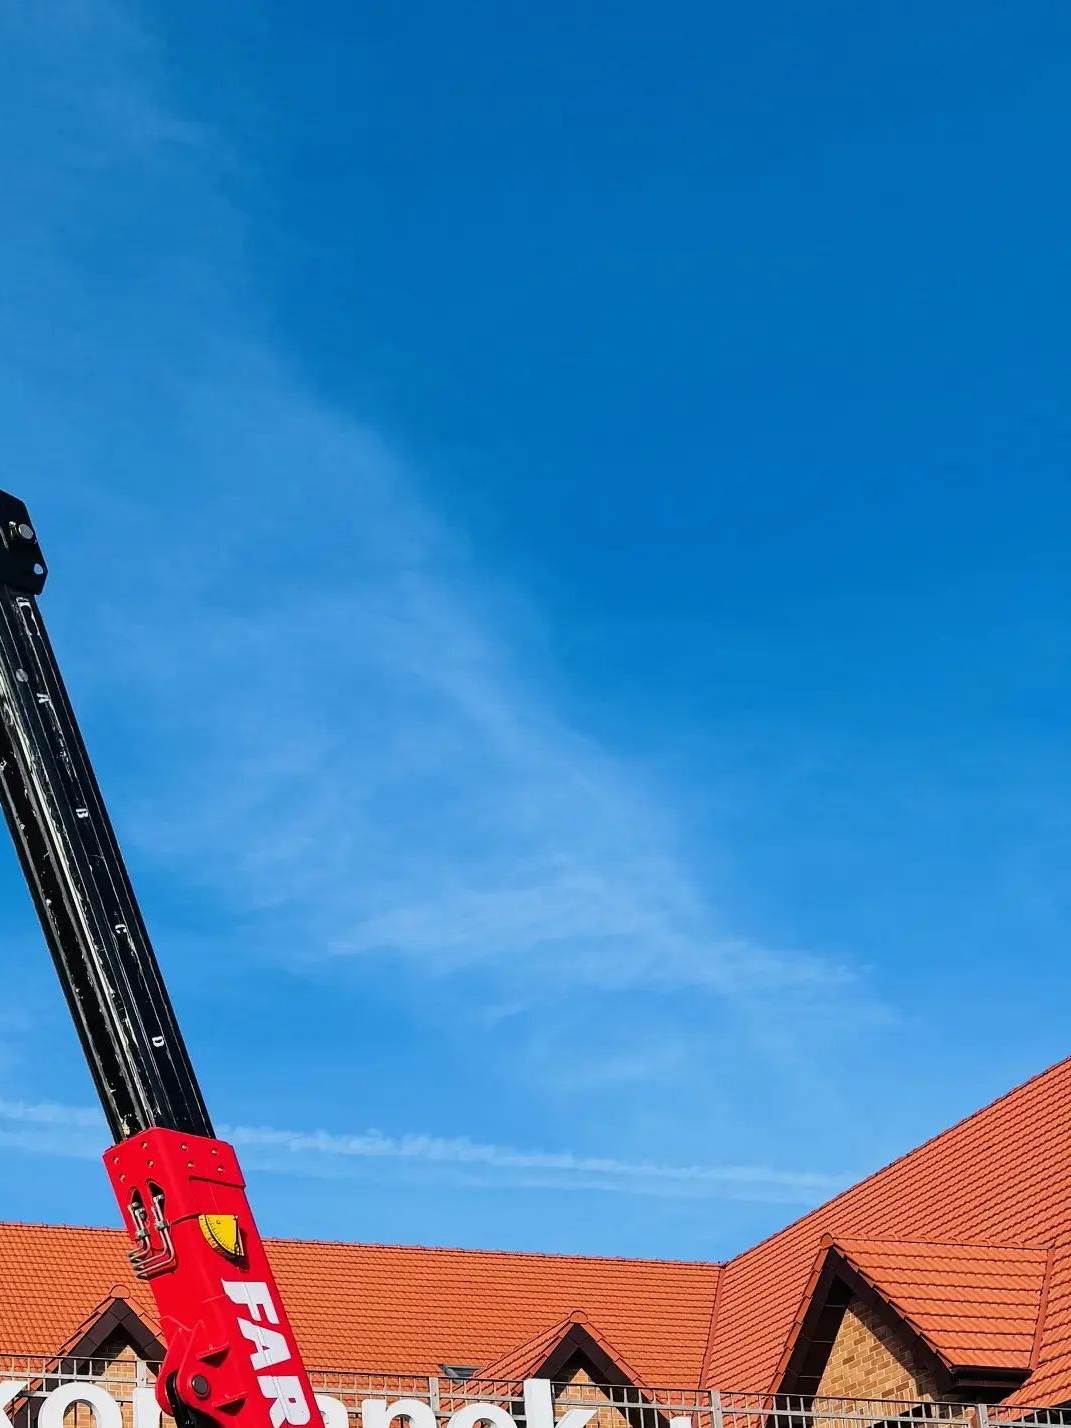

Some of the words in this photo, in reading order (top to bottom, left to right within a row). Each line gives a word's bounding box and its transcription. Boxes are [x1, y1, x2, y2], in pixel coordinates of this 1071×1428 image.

[75, 808, 89, 819] B
[114, 923, 127, 935] C
[151, 1035, 165, 1048] D
